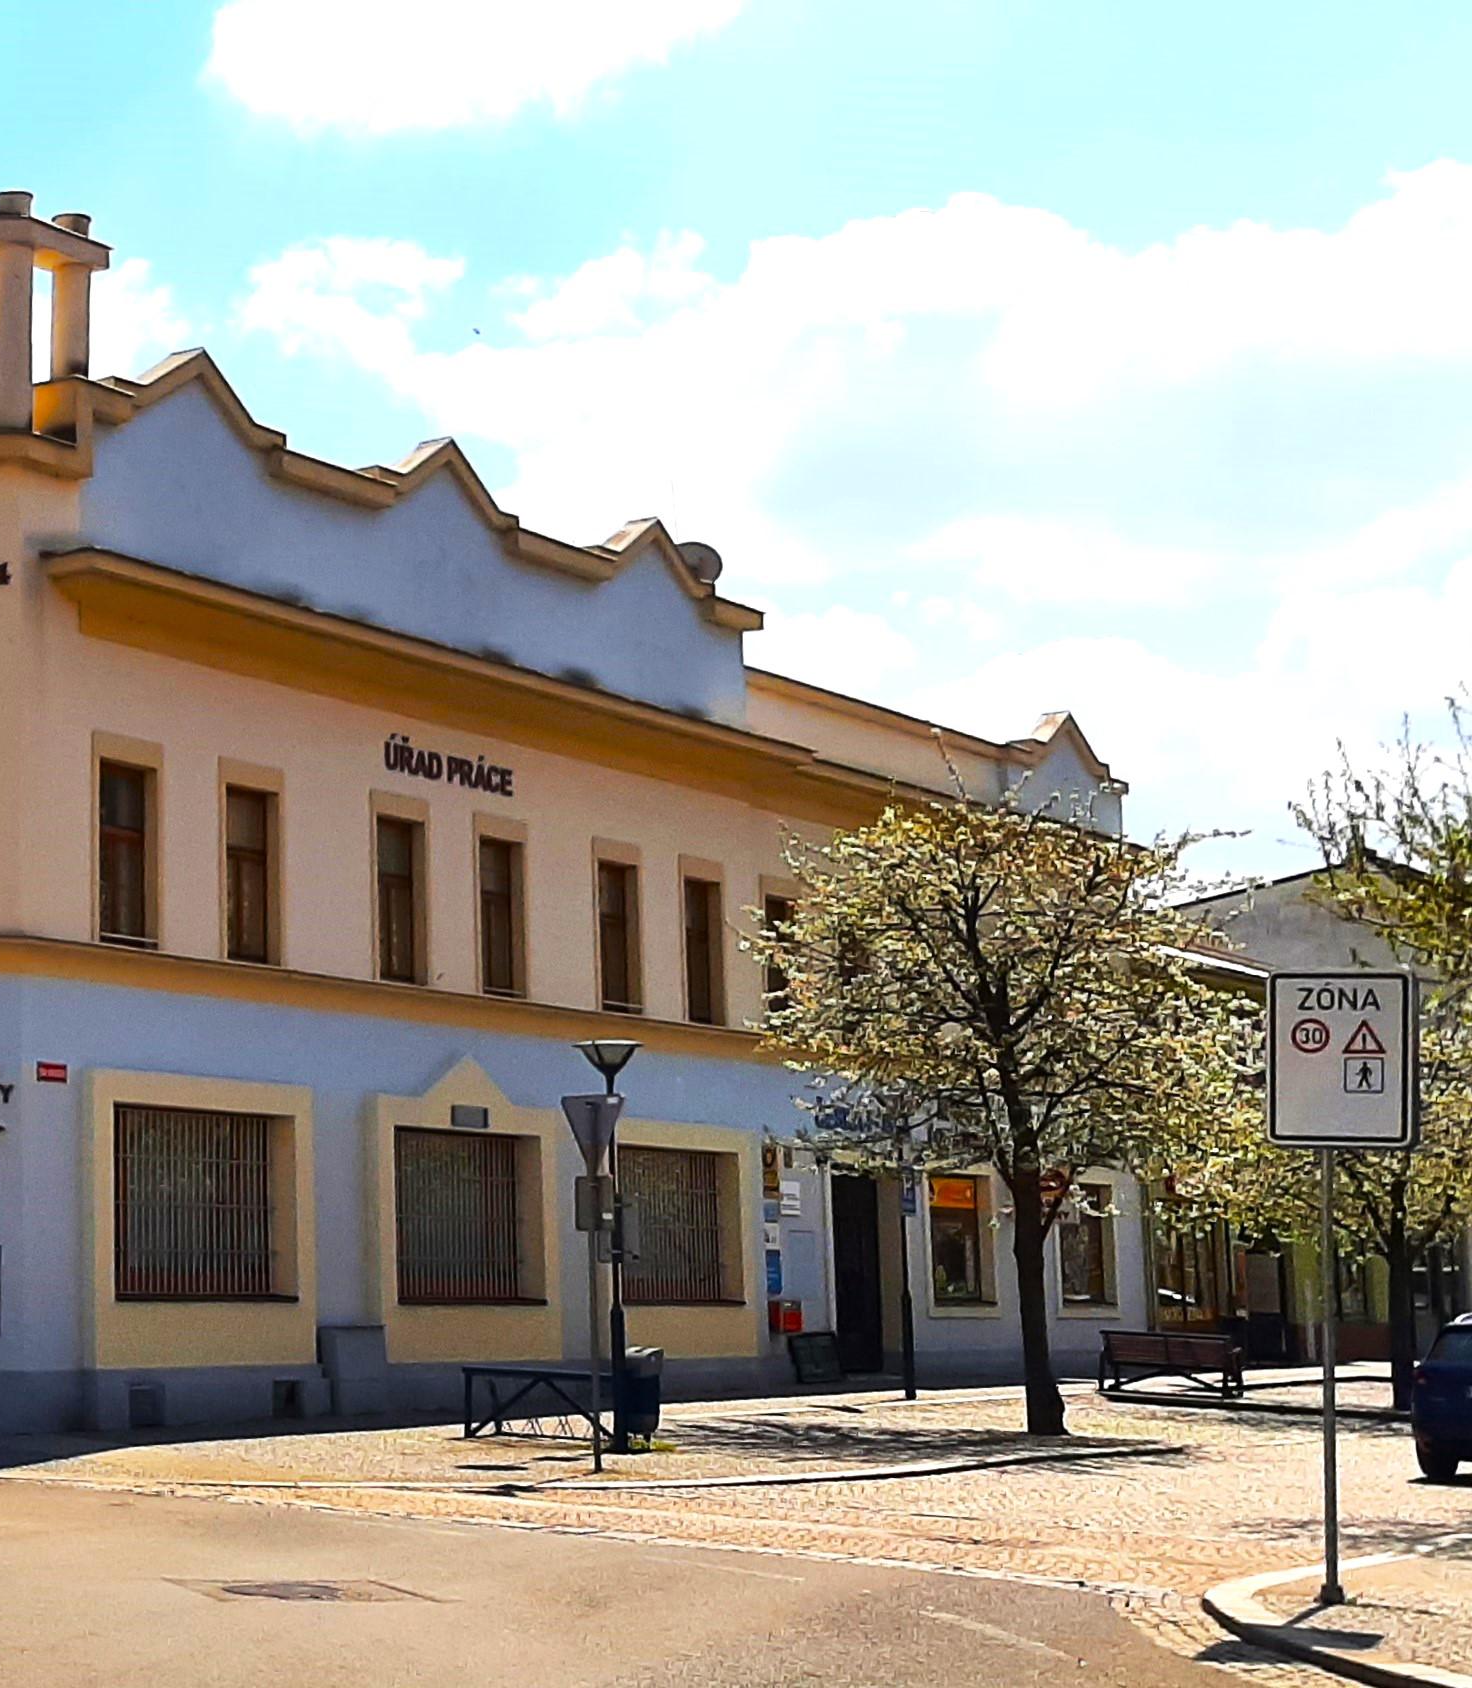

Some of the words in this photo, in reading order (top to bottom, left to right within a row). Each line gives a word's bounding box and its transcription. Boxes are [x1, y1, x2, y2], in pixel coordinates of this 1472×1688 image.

[384, 733, 443, 780] ÚŘAD
[447, 755, 513, 797] PRÁCE
[1297, 982, 1381, 1011] ZÓNA
[1299, 1027, 1323, 1045] 30
